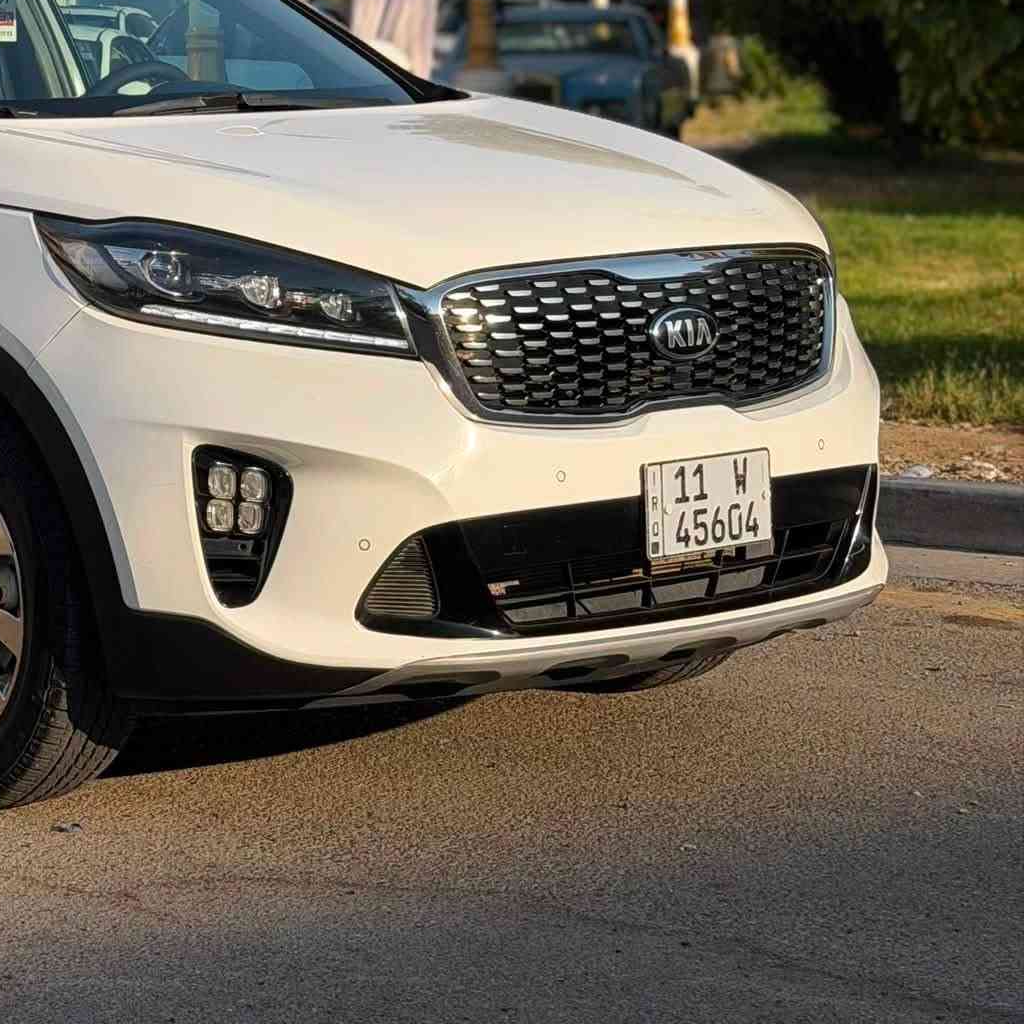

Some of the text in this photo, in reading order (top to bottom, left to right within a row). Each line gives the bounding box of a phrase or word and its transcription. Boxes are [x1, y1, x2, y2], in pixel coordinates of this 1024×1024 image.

[664, 316, 714, 350] KIA
[674, 456, 748, 504] 11 W
[675, 500, 760, 548] 45604
